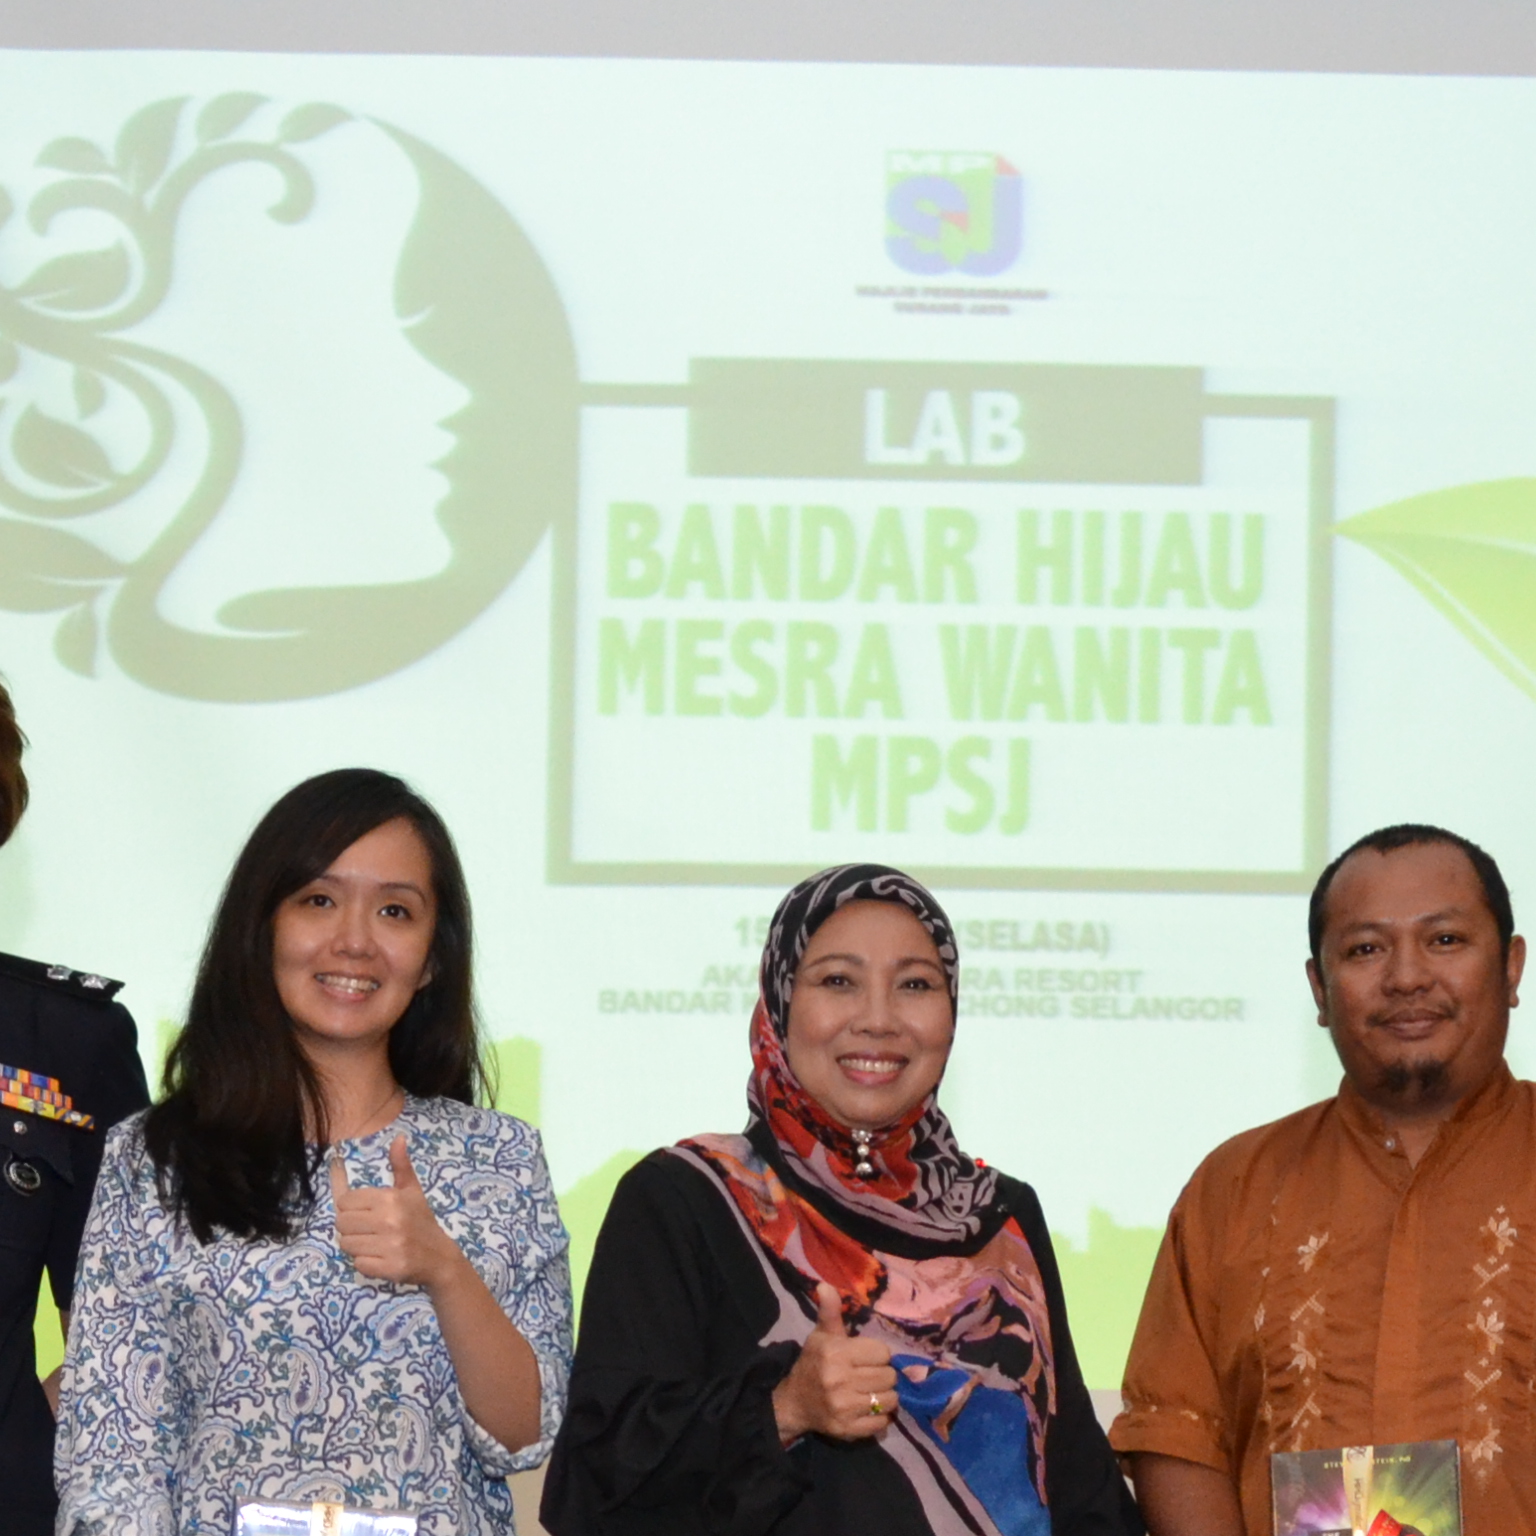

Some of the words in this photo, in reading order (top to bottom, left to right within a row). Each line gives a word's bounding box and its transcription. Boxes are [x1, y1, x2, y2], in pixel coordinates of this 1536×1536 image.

[865, 387, 1026, 466] LAB
[607, 502, 980, 604] BANDAR
[1016, 508, 1266, 611] HIJAU
[597, 617, 905, 720] MESRA
[939, 622, 1274, 727] WANITA
[810, 733, 1032, 837] MPSJ
[597, 989, 732, 1014] BANDAR
[1069, 995, 1246, 1022] SELANGOR
[1013, 967, 1144, 994] RESORT
